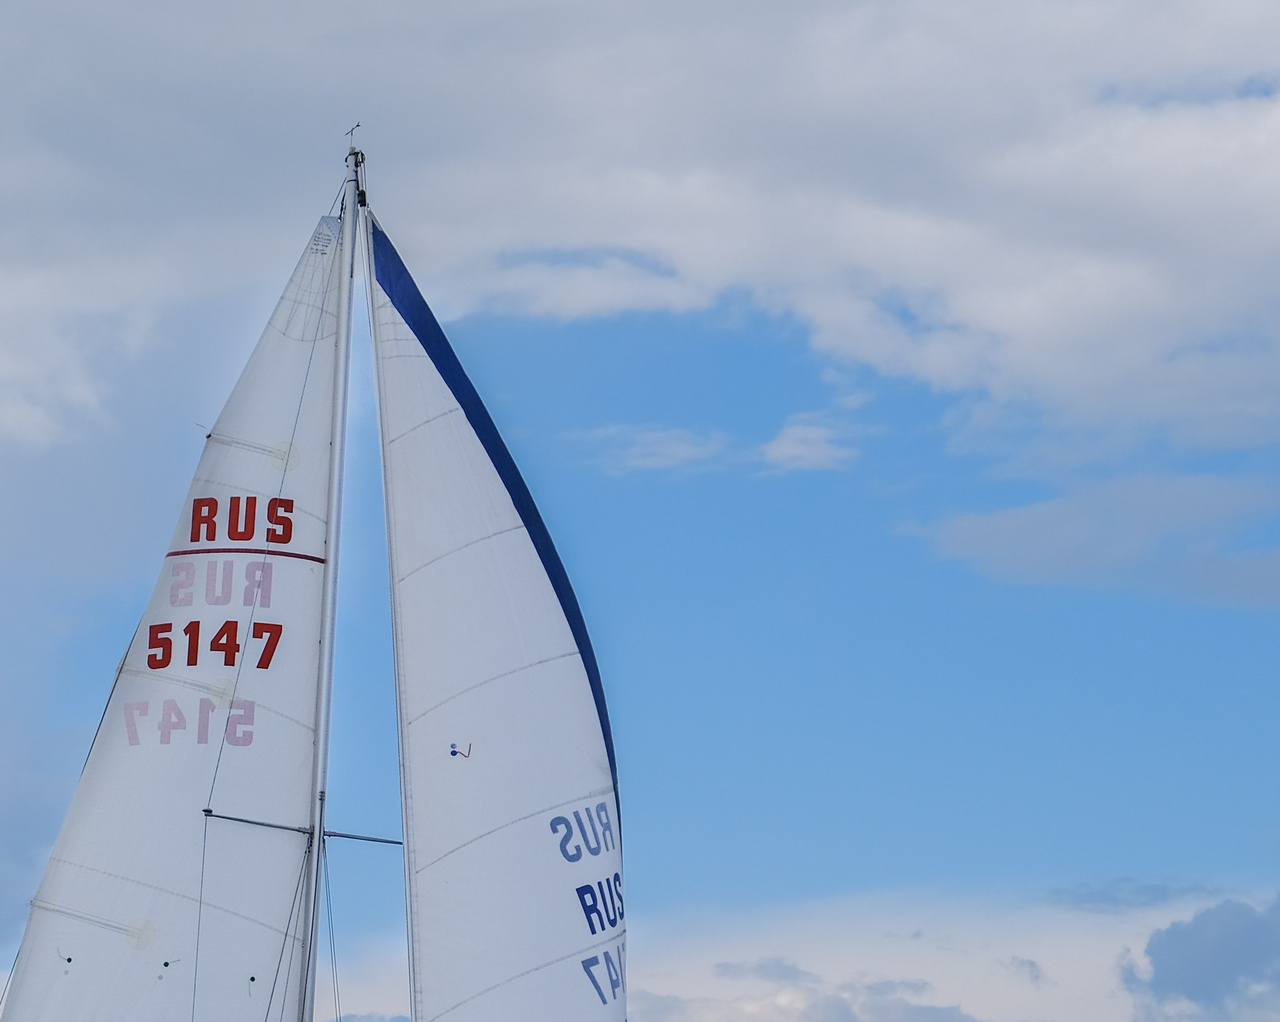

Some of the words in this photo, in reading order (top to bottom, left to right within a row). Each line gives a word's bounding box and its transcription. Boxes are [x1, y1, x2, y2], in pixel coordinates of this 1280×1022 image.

[190, 496, 294, 544] RUS
[147, 620, 283, 669] 5147
[575, 872, 624, 936] RUS
